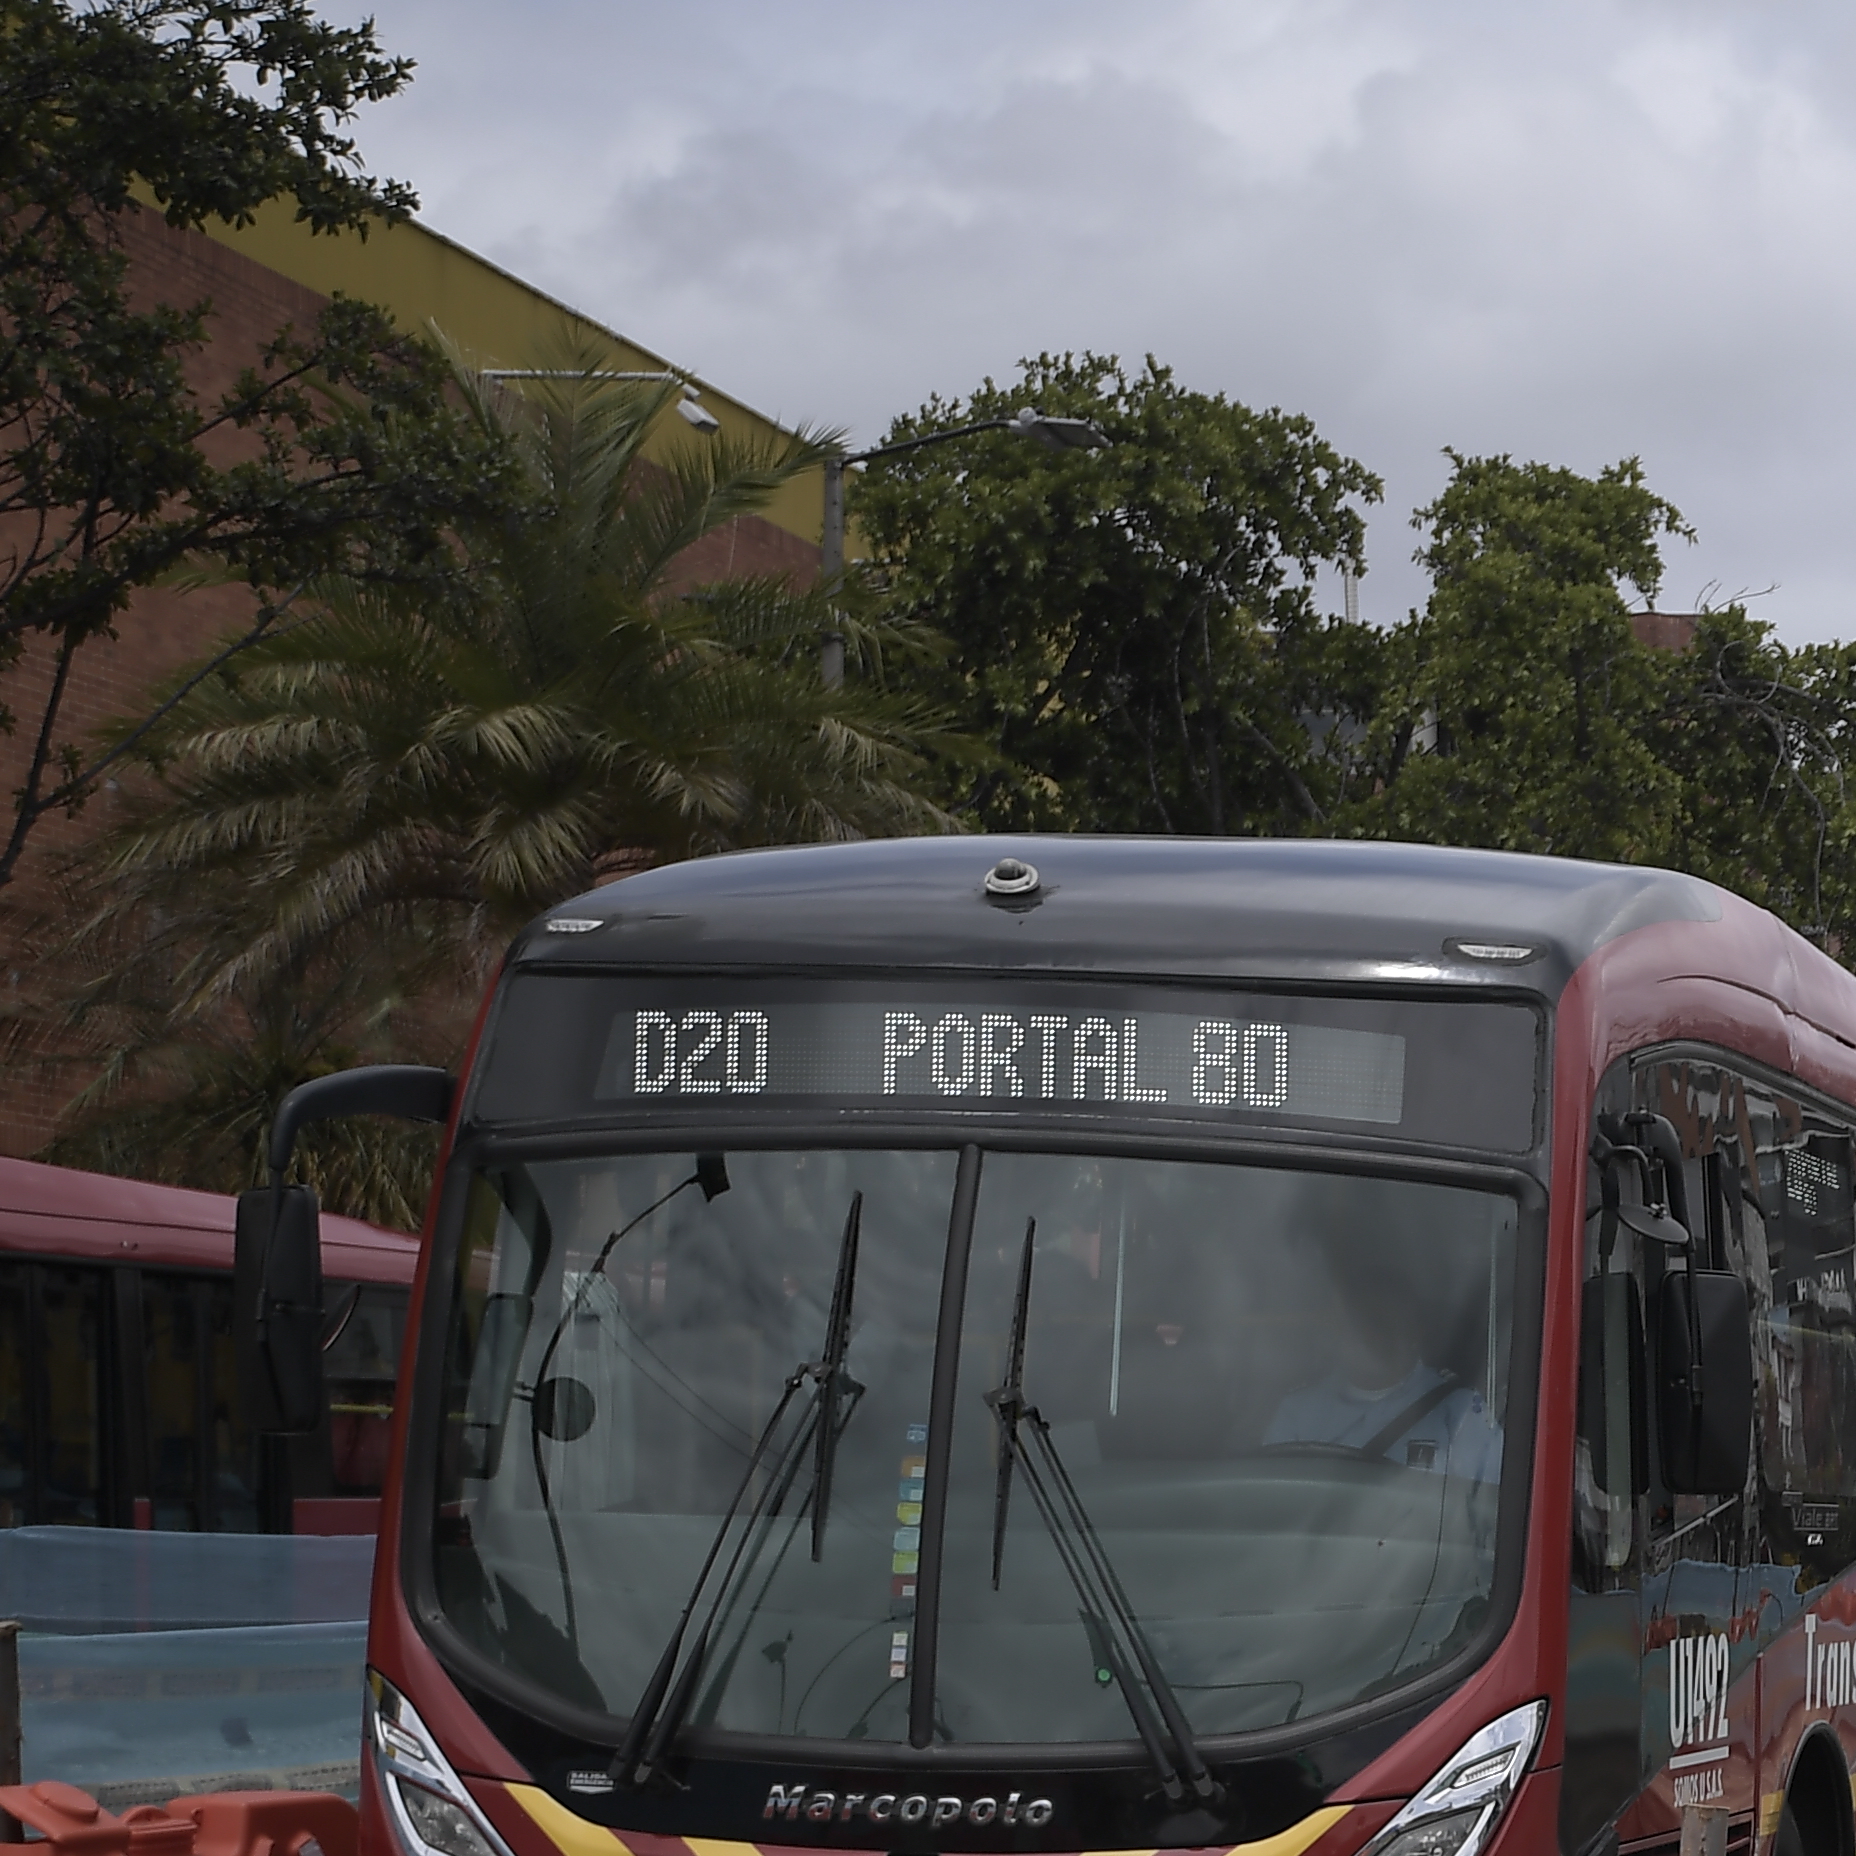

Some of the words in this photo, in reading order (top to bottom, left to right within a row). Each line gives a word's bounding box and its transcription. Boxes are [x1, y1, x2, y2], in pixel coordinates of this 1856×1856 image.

[633, 1008, 769, 1093] D20
[882, 1011, 1168, 1102] PORTAL
[1190, 1020, 1290, 1107] 80
[1792, 1508, 1823, 1527] Viale
[1669, 1632, 1729, 1749] U1492
[763, 1784, 1053, 1827] Marcopolo
